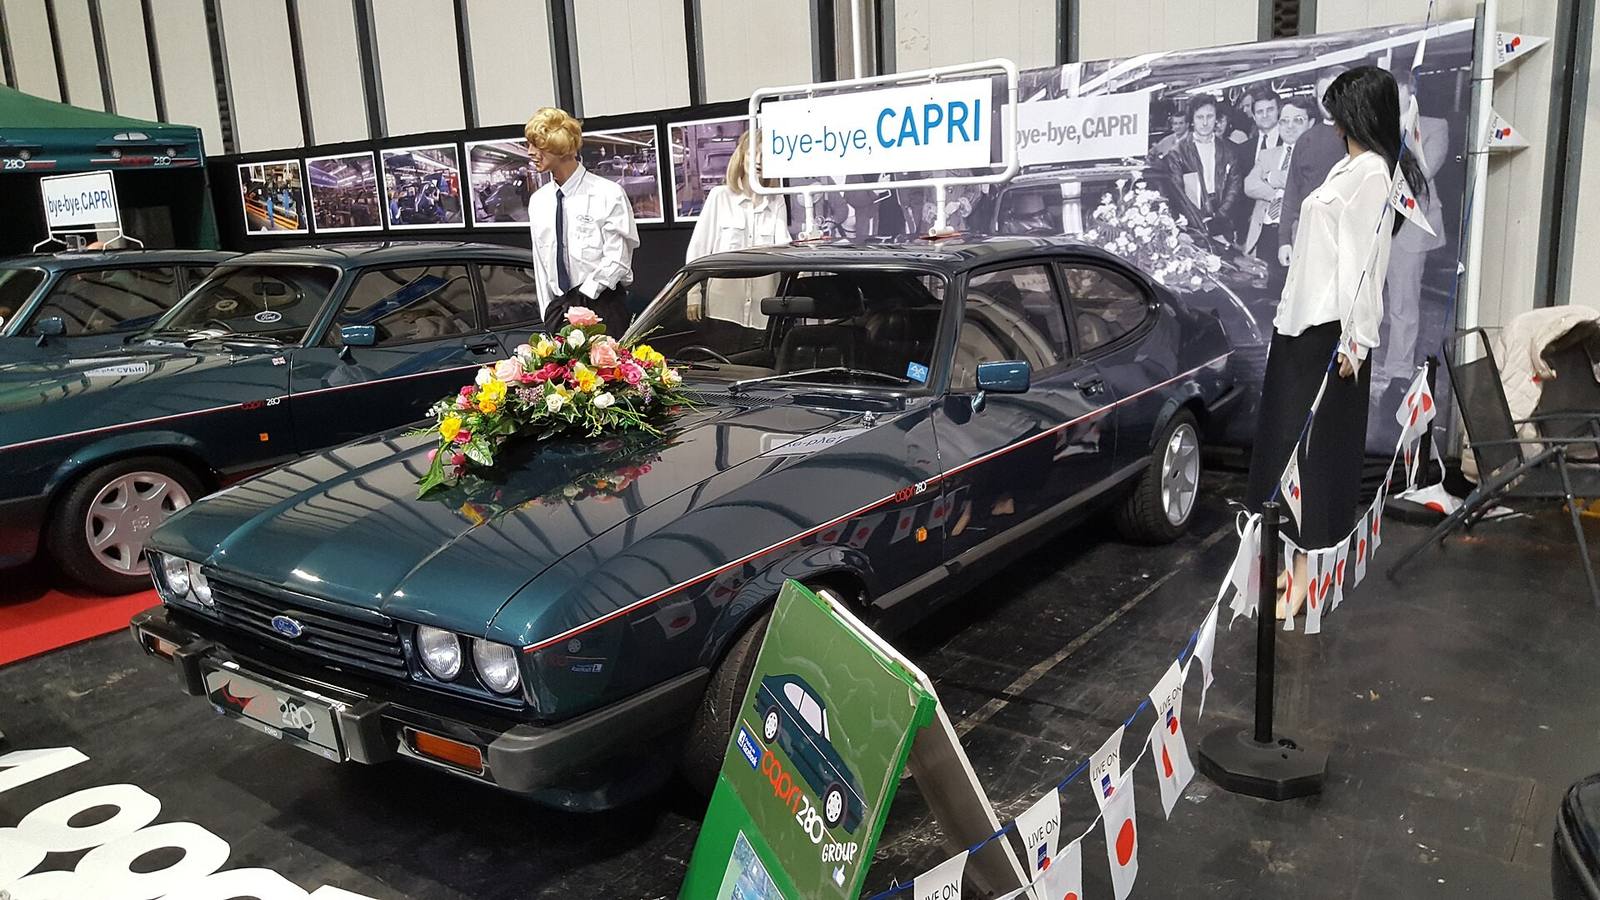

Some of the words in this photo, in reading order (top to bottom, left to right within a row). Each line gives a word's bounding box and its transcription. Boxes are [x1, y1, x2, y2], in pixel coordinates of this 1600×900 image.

[772, 126, 872, 161] bye-bye,
[876, 99, 980, 149] CAPRI
[1082, 114, 1138, 139] CAPRI
[3, 159, 26, 169] 280
[81, 189, 112, 210] CAPRI
[266, 397, 280, 406] 280
[914, 481, 927, 495] 280
[277, 697, 315, 734] 280
[795, 794, 824, 844] 280
[1028, 826, 1044, 849] LIVE
[1046, 815, 1058, 835] ON
[822, 841, 858, 864] GROUP
[943, 880, 959, 900] ON
